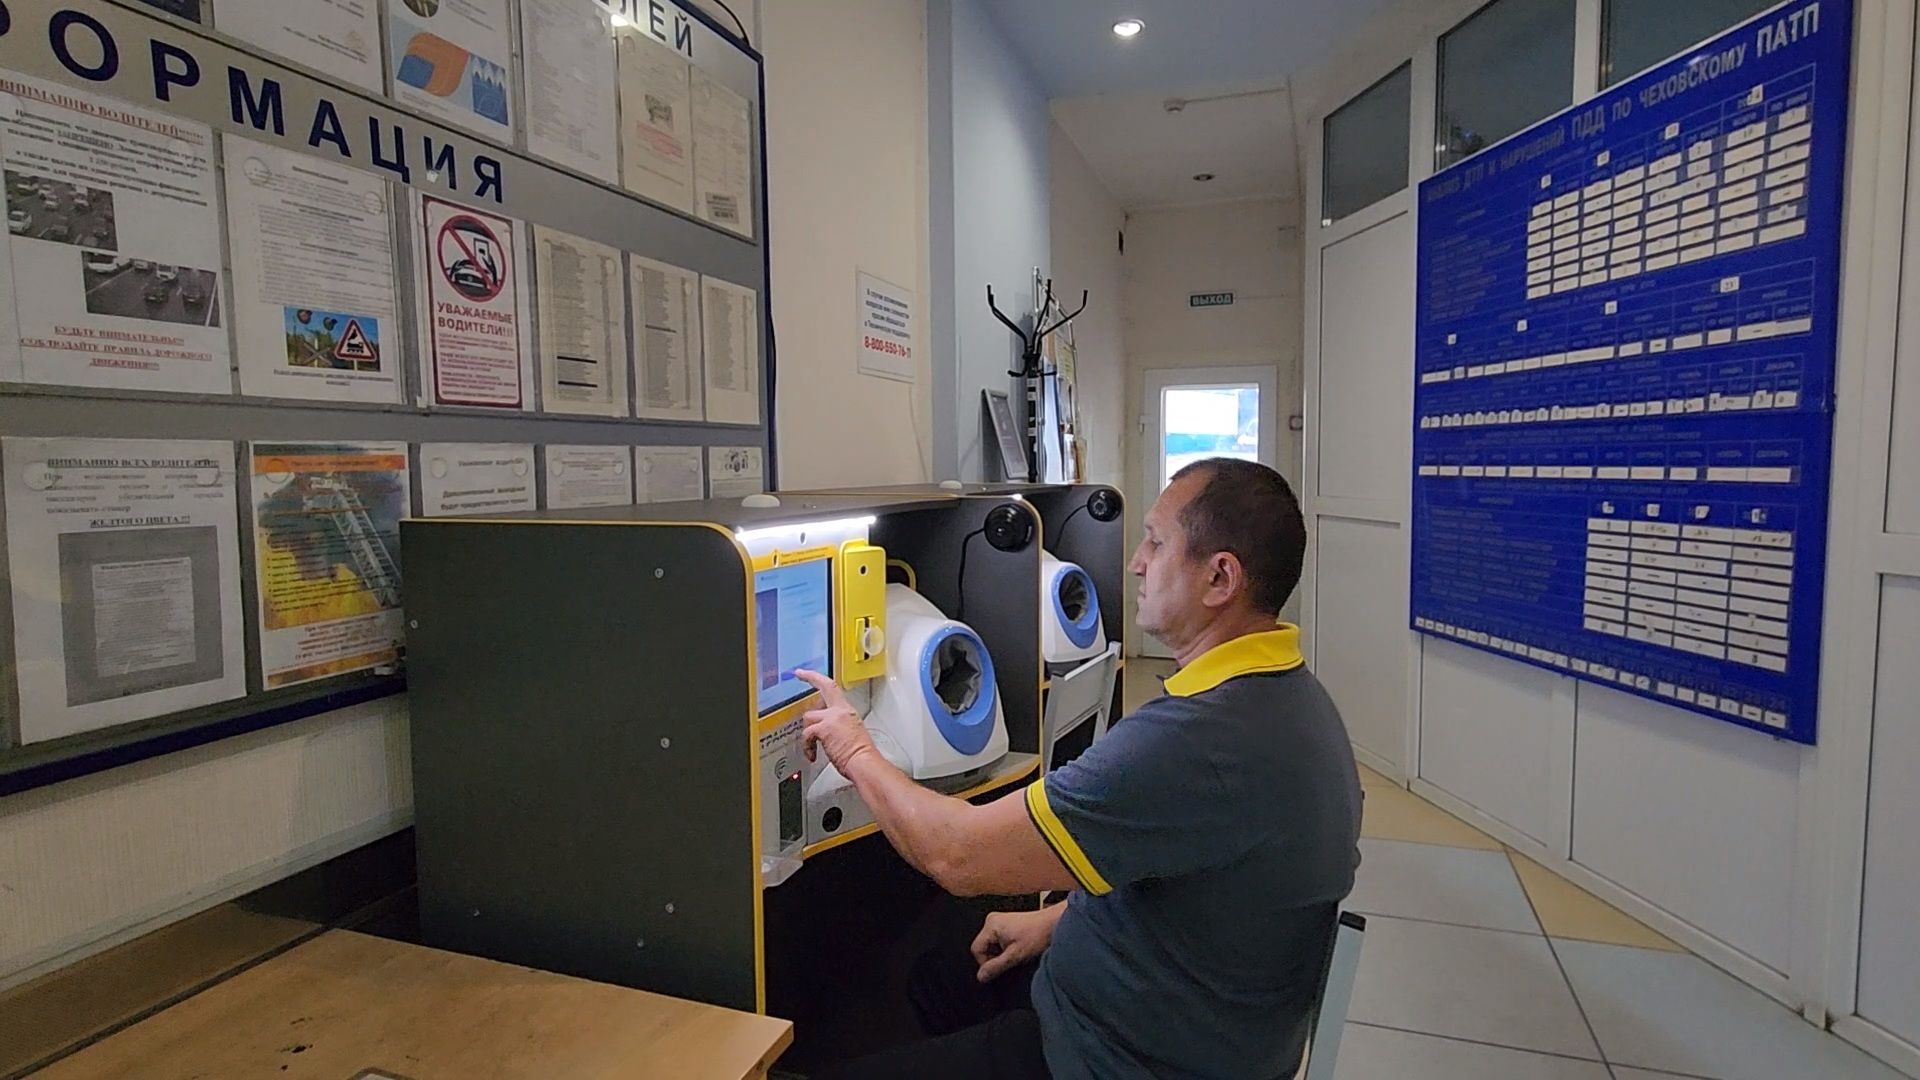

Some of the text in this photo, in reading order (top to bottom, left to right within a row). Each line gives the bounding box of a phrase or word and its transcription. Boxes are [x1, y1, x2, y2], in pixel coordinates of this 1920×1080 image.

[599, 0, 692, 57] ЛЕЙ
[1572, 105, 1606, 140] ПДД
[1612, 97, 1632, 122] ПО
[1639, 42, 1747, 108] ЧЕХОВСКОМУ
[1756, 2, 1820, 58] ПАТП
[0, 0, 503, 204] ОРМАЦИЯ
[437, 301, 513, 324] УВАЖАЕМЫЕ
[1191, 294, 1232, 305] ВЫХОД
